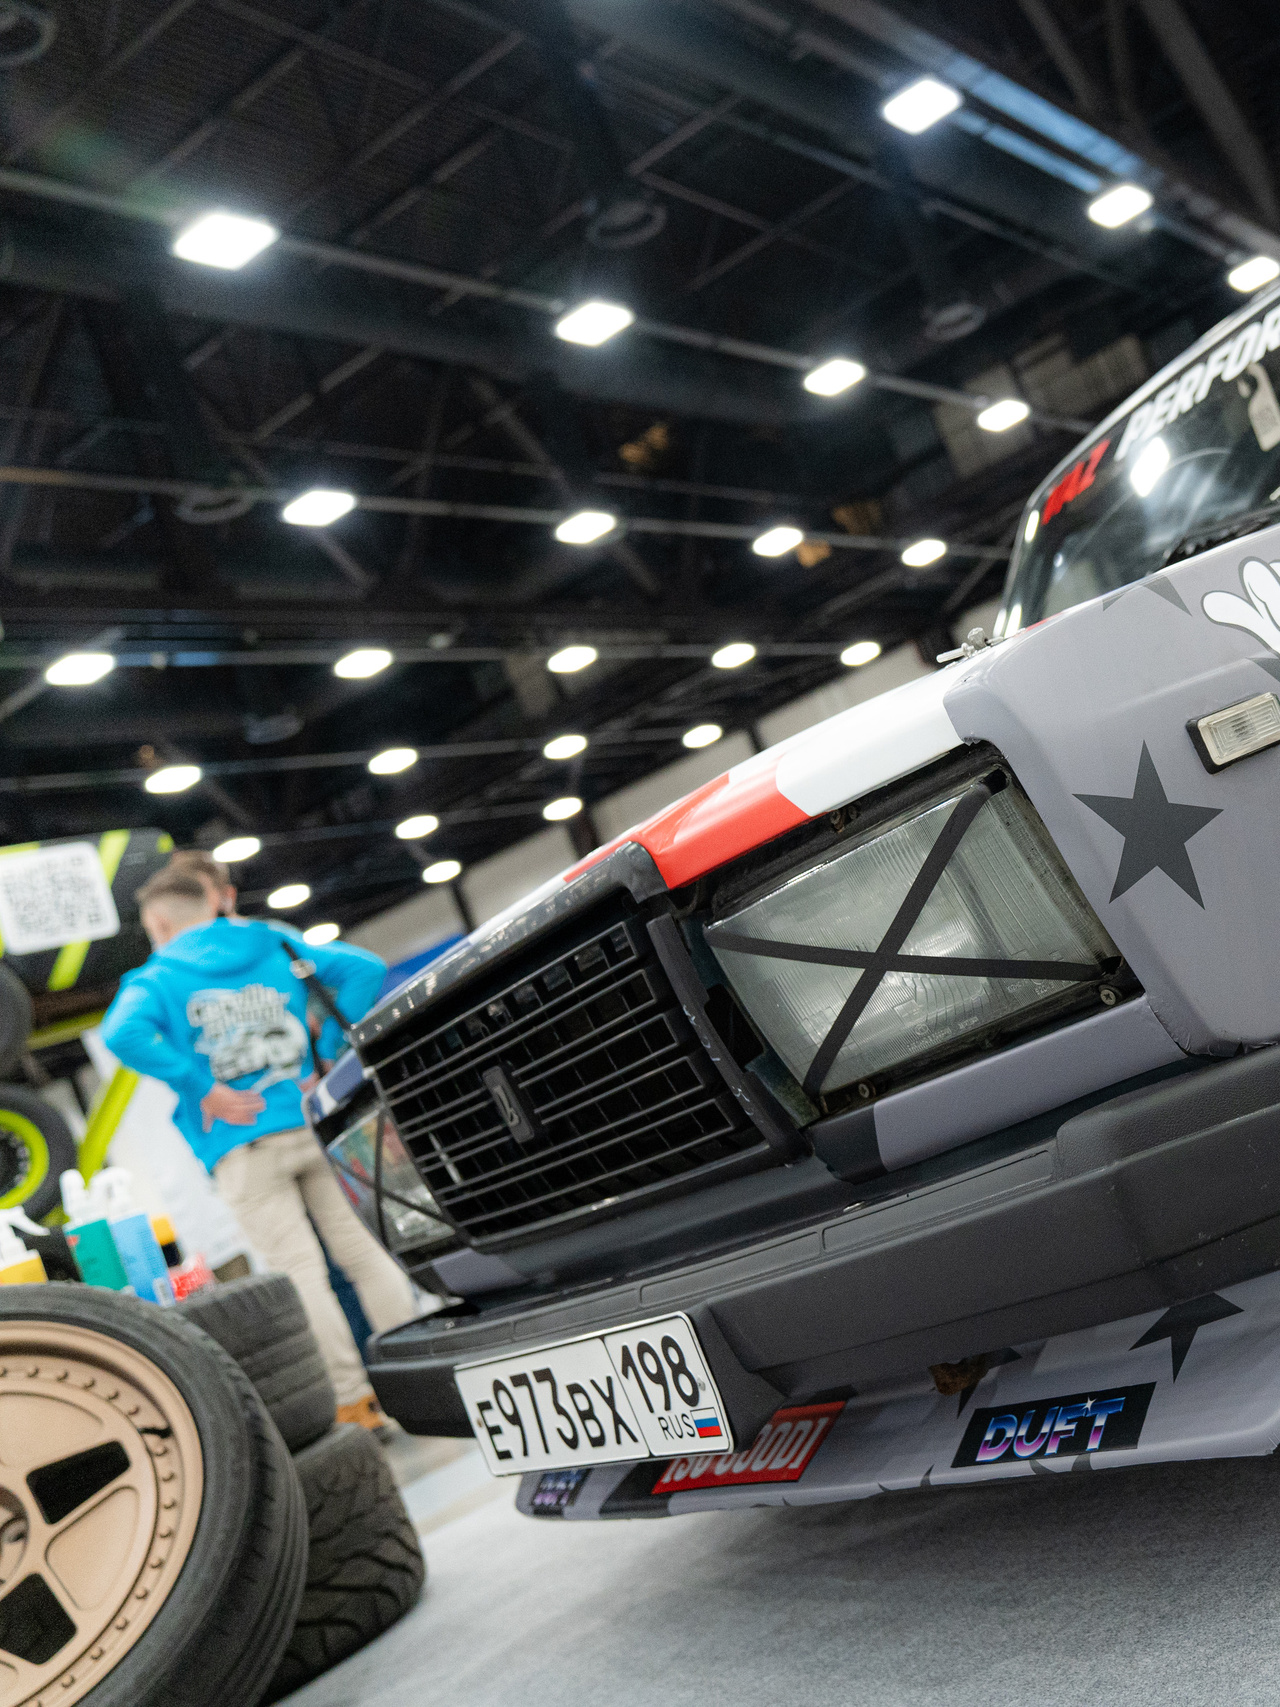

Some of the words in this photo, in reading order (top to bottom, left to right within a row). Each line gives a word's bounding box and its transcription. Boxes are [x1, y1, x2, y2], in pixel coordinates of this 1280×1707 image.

[621, 1334, 701, 1414] 198
[657, 1413, 697, 1441] RUS
[974, 1396, 1127, 1464] DUFT
